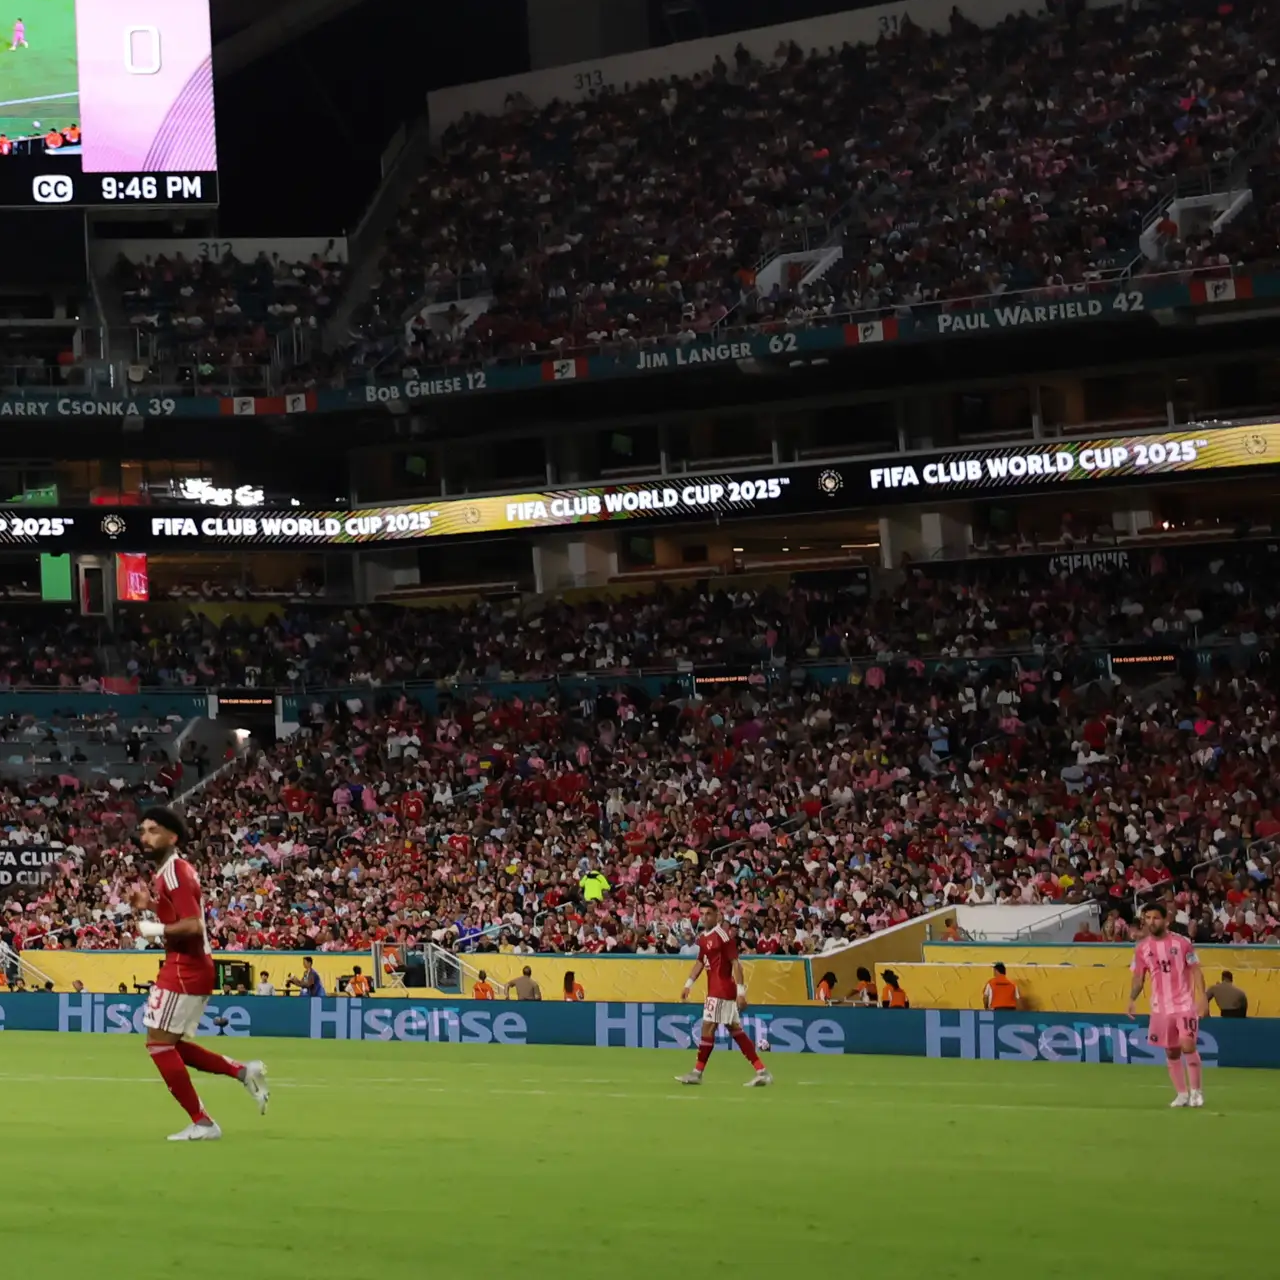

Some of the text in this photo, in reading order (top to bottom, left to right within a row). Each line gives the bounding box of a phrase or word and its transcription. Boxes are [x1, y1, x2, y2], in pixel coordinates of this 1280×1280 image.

[123, 25, 162, 75] 0
[573, 69, 604, 90] 313
[101, 176, 202, 199] 9:46 PM
[937, 291, 1145, 334] PAUL WARFIELD 42
[636, 333, 798, 371] JIM LANGER 62
[365, 372, 487, 403] BOB GRIESE 12
[57, 398, 139, 417] CSONKA
[148, 398, 176, 417] 39
[869, 464, 919, 490] FIFA
[922, 458, 983, 485] CLUB
[986, 449, 1074, 479] WORLD
[1078, 444, 1129, 470] CUP
[506, 500, 546, 522] FIFA
[550, 495, 601, 519] CLUB
[604, 488, 679, 514] WORLD
[685, 483, 726, 507] CUP
[57, 993, 252, 1038] Hisse
[309, 996, 528, 1045] Hisense
[1183, 1016, 1198, 1032] 10
